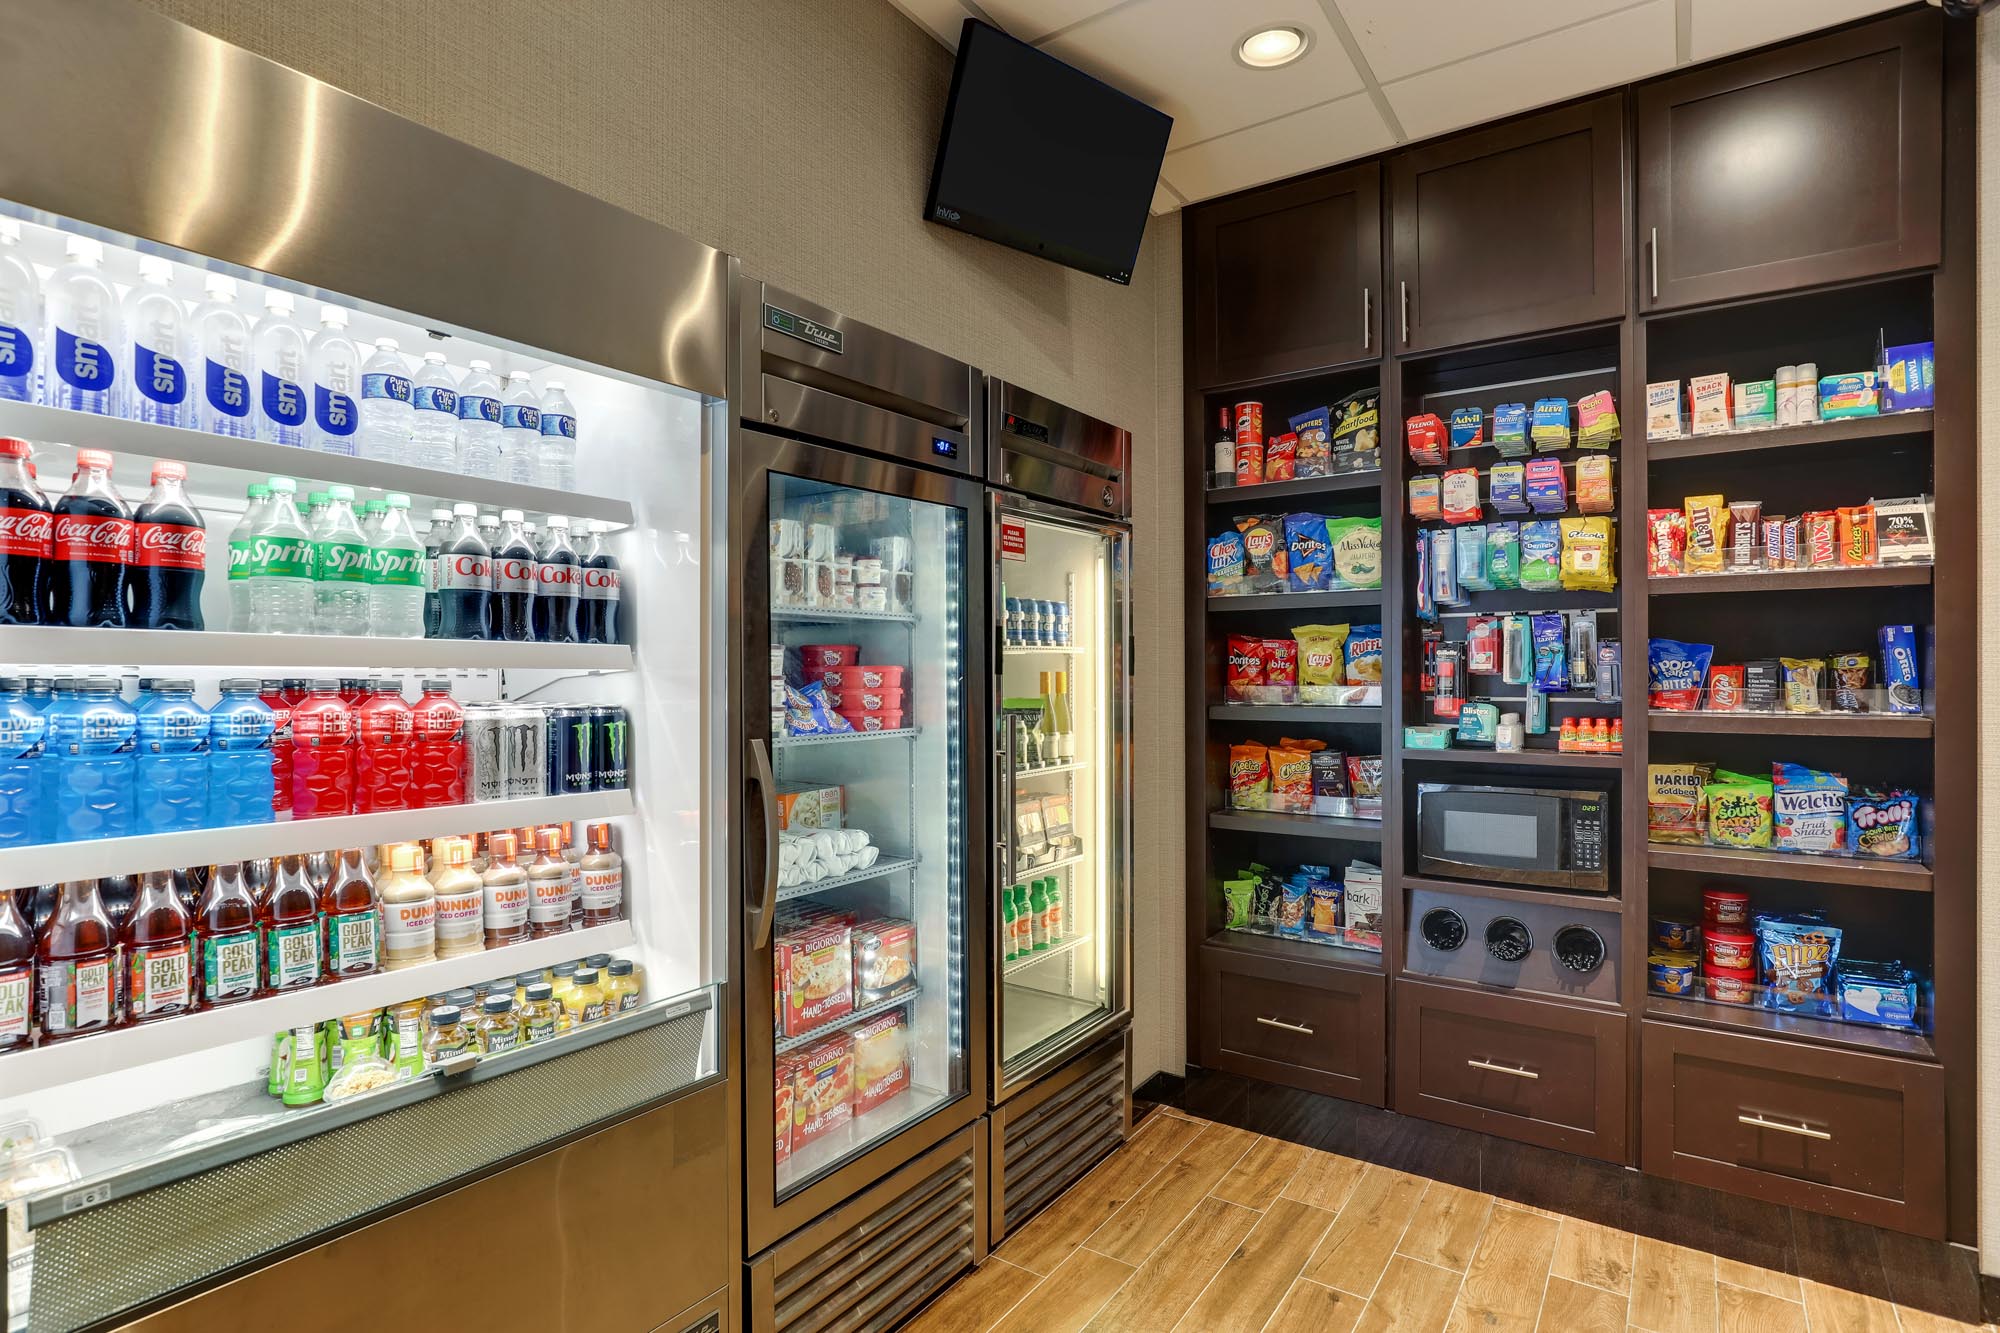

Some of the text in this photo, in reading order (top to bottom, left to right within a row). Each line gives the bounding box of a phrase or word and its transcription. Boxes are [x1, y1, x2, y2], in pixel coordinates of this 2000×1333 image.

[1908, 359, 1919, 392] TAMPAX
[1696, 381, 1723, 393] SNACK
[1650, 389, 1675, 400] SNACK
[1580, 399, 1603, 410] Pepto
[1295, 419, 1323, 432] PLANTERS
[1335, 415, 1376, 435] smartfood
[1408, 420, 1435, 430] TYLENOL
[1454, 414, 1480, 424] Advil
[1888, 516, 1913, 526] 70%
[55, 517, 133, 546] Coca-Cola
[1568, 531, 1607, 542] Ricola
[1211, 542, 1237, 559] Chex
[1291, 541, 1326, 552] Doritos
[1229, 654, 1260, 666] Doritos
[1271, 659, 1291, 669] bits
[1893, 647, 1912, 682] OREO
[1663, 679, 1693, 690] BITES
[1462, 707, 1489, 717] Blistex
[1231, 761, 1261, 778] Cheetos
[1280, 761, 1312, 780] Cheetos
[1780, 791, 1843, 810] Welch's
[1719, 806, 1759, 818] SOUR
[1855, 801, 1912, 829] Trolli
[1717, 816, 1761, 829] PATCH
[1801, 820, 1826, 830] Fruit
[1792, 827, 1833, 838] Snacks
[343, 921, 372, 937] GOLD
[284, 933, 315, 951] GOLD
[343, 933, 373, 949] PEAK
[222, 942, 254, 960] GOLD
[284, 945, 315, 963] PEAK
[1771, 943, 1831, 969] Flipz
[150, 957, 185, 975] GOLD
[223, 956, 254, 975] PEAK
[81, 966, 105, 979] GOLD
[81, 977, 105, 990] PEAK
[151, 970, 187, 989] PEAK
